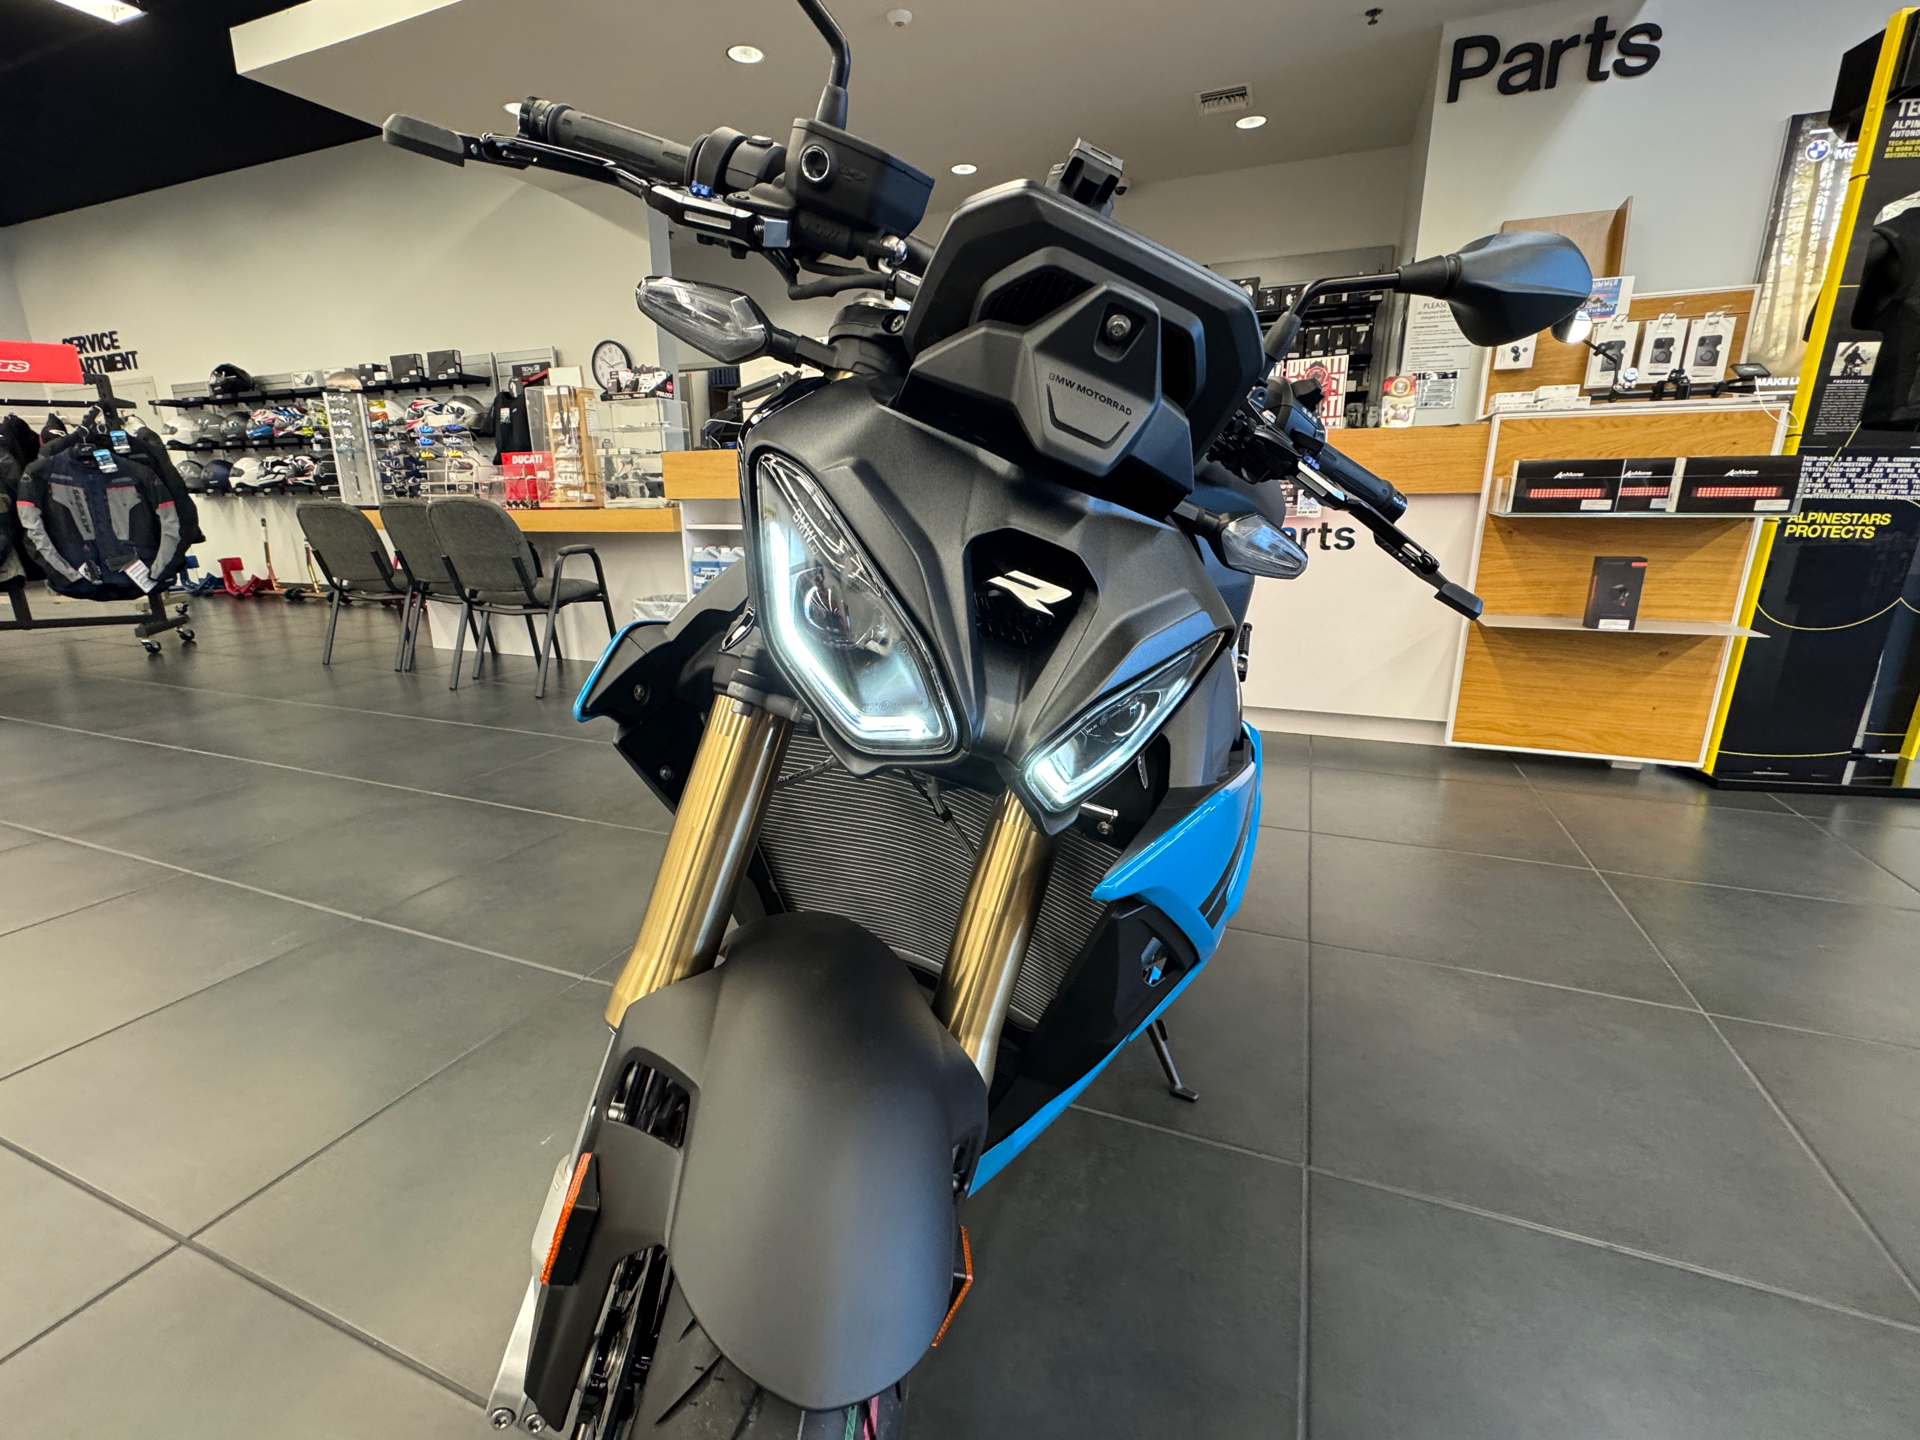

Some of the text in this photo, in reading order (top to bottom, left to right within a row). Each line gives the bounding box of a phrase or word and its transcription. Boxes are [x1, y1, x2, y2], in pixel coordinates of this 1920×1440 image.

[1447, 15, 1663, 103] Parts
[1592, 280, 1619, 289] UMMER
[78, 350, 139, 375] ARTMENT
[1759, 377, 1789, 386] MAKE
[1048, 372, 1133, 416] BMW MOTORRAD
[512, 454, 543, 465] DUCATI
[792, 508, 818, 544] BMW
[1787, 511, 1892, 526] ALPINESTARS
[1281, 522, 1356, 551] arts
[1784, 524, 1876, 540] PROTECTS
